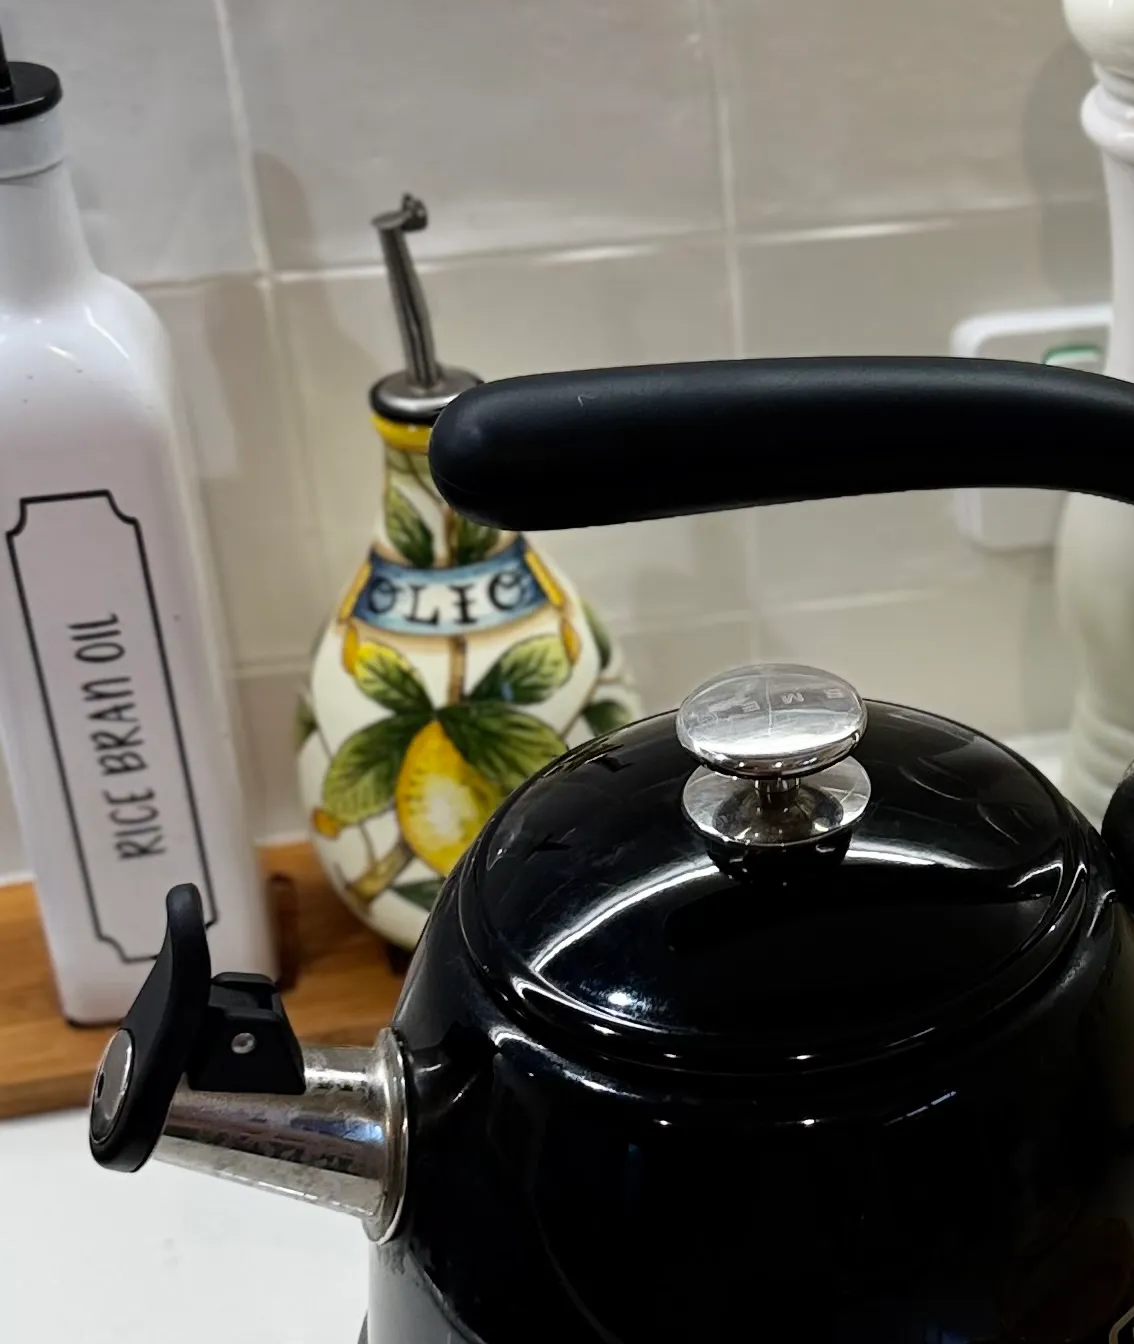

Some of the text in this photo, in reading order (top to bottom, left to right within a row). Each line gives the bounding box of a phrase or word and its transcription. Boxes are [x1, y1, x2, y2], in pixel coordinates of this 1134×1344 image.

[367, 570, 525, 626] OLIO
[67, 612, 167, 861] RICE BRAN OIL
